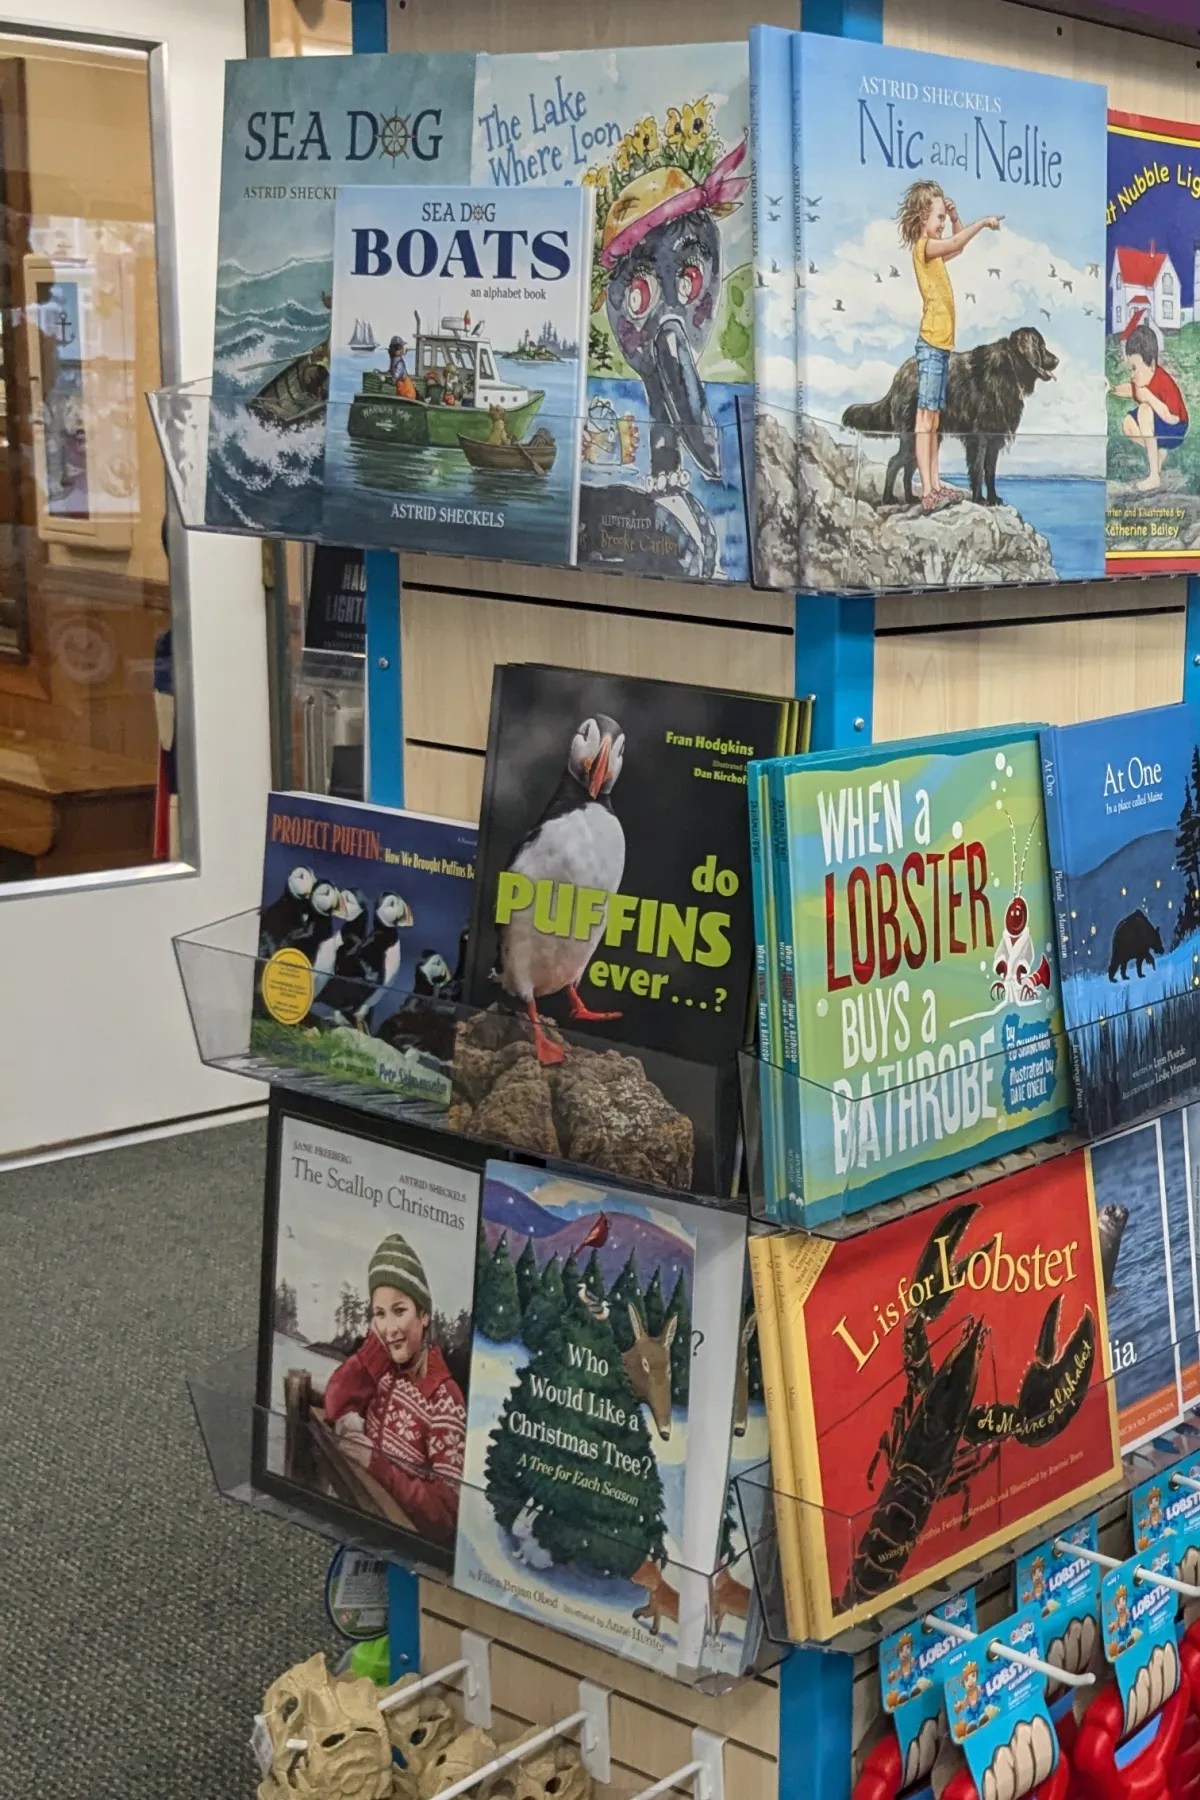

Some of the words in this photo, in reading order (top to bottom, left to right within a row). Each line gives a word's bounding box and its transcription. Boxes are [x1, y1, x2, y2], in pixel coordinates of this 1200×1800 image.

[859, 75, 919, 100] ASTRID
[922, 86, 1002, 113] SHECKELS
[478, 104, 522, 152] The
[529, 75, 587, 134] Lake
[245, 111, 331, 161] SEA
[488, 143, 563, 187] Where
[570, 122, 622, 165] Loon
[858, 99, 924, 169] Nic
[930, 133, 969, 171] and
[974, 116, 1063, 189] Nellie
[243, 187, 286, 200] ASTRID
[290, 187, 337, 200] SHECK
[1117, 162, 1170, 213] Nubble
[422, 202, 456, 222] SEA
[350, 228, 571, 282] BOATS
[470, 289, 482, 298] an
[483, 287, 521, 300] alphabet
[524, 288, 547, 300] book
[390, 503, 437, 521] ASTRID
[439, 507, 505, 528] SHECKELS
[1138, 507, 1175, 519] Illustrated
[1176, 508, 1186, 520] by
[1151, 523, 1179, 539] Bailey
[666, 731, 693, 747] Fran
[695, 735, 755, 756] Hodgkins
[693, 767, 712, 780] Dan
[713, 770, 749, 786] Kirchof
[1043, 759, 1054, 774] At
[1046, 774, 1056, 797] One
[1103, 763, 1126, 797] At
[1128, 756, 1163, 789] One
[1105, 803, 1113, 815] In
[1118, 798, 1132, 815] place
[1131, 793, 1147, 808] called
[1147, 791, 1164, 803] Maine
[271, 813, 329, 851] PROJECT
[816, 779, 904, 867] WHEN
[913, 788, 931, 846] a
[384, 848, 400, 864] How
[400, 850, 413, 868] We
[413, 852, 442, 875] Brought
[441, 858, 467, 879] Puffins
[691, 854, 740, 897] do
[1054, 870, 1065, 902] Plourde
[495, 870, 732, 968] PUFFINS
[824, 841, 995, 993] LOBSTER
[841, 980, 911, 1070] BUYS
[921, 988, 937, 1045] a
[1005, 1024, 1016, 1043] by
[1009, 1057, 1044, 1086] illustrated
[1044, 1056, 1055, 1075] by
[831, 1025, 998, 1176] BATHROBE
[291, 1156, 323, 1185] The
[327, 1166, 384, 1208] Scallop
[387, 1186, 466, 1231] Christmas
[399, 1174, 428, 1190] ASTRID
[428, 1182, 468, 1203] SHECKELS
[831, 1314, 880, 1373] L
[873, 1300, 901, 1337] is
[897, 1273, 936, 1316] for
[933, 1231, 1079, 1294] Lobster
[568, 1342, 610, 1377] Who
[530, 1373, 584, 1412] Would
[587, 1392, 626, 1427] Like
[628, 1414, 640, 1432] a
[977, 1409, 995, 1433] A
[1047, 1338, 1093, 1425] Alphabet
[509, 1410, 600, 1460] Christmas
[602, 1439, 653, 1480] Tree?
[516, 1453, 528, 1468] A
[525, 1455, 555, 1476] Tree
[552, 1464, 572, 1481] for
[571, 1470, 601, 1493] Each
[600, 1481, 639, 1508] Season
[605, 1617, 632, 1638] Anne
